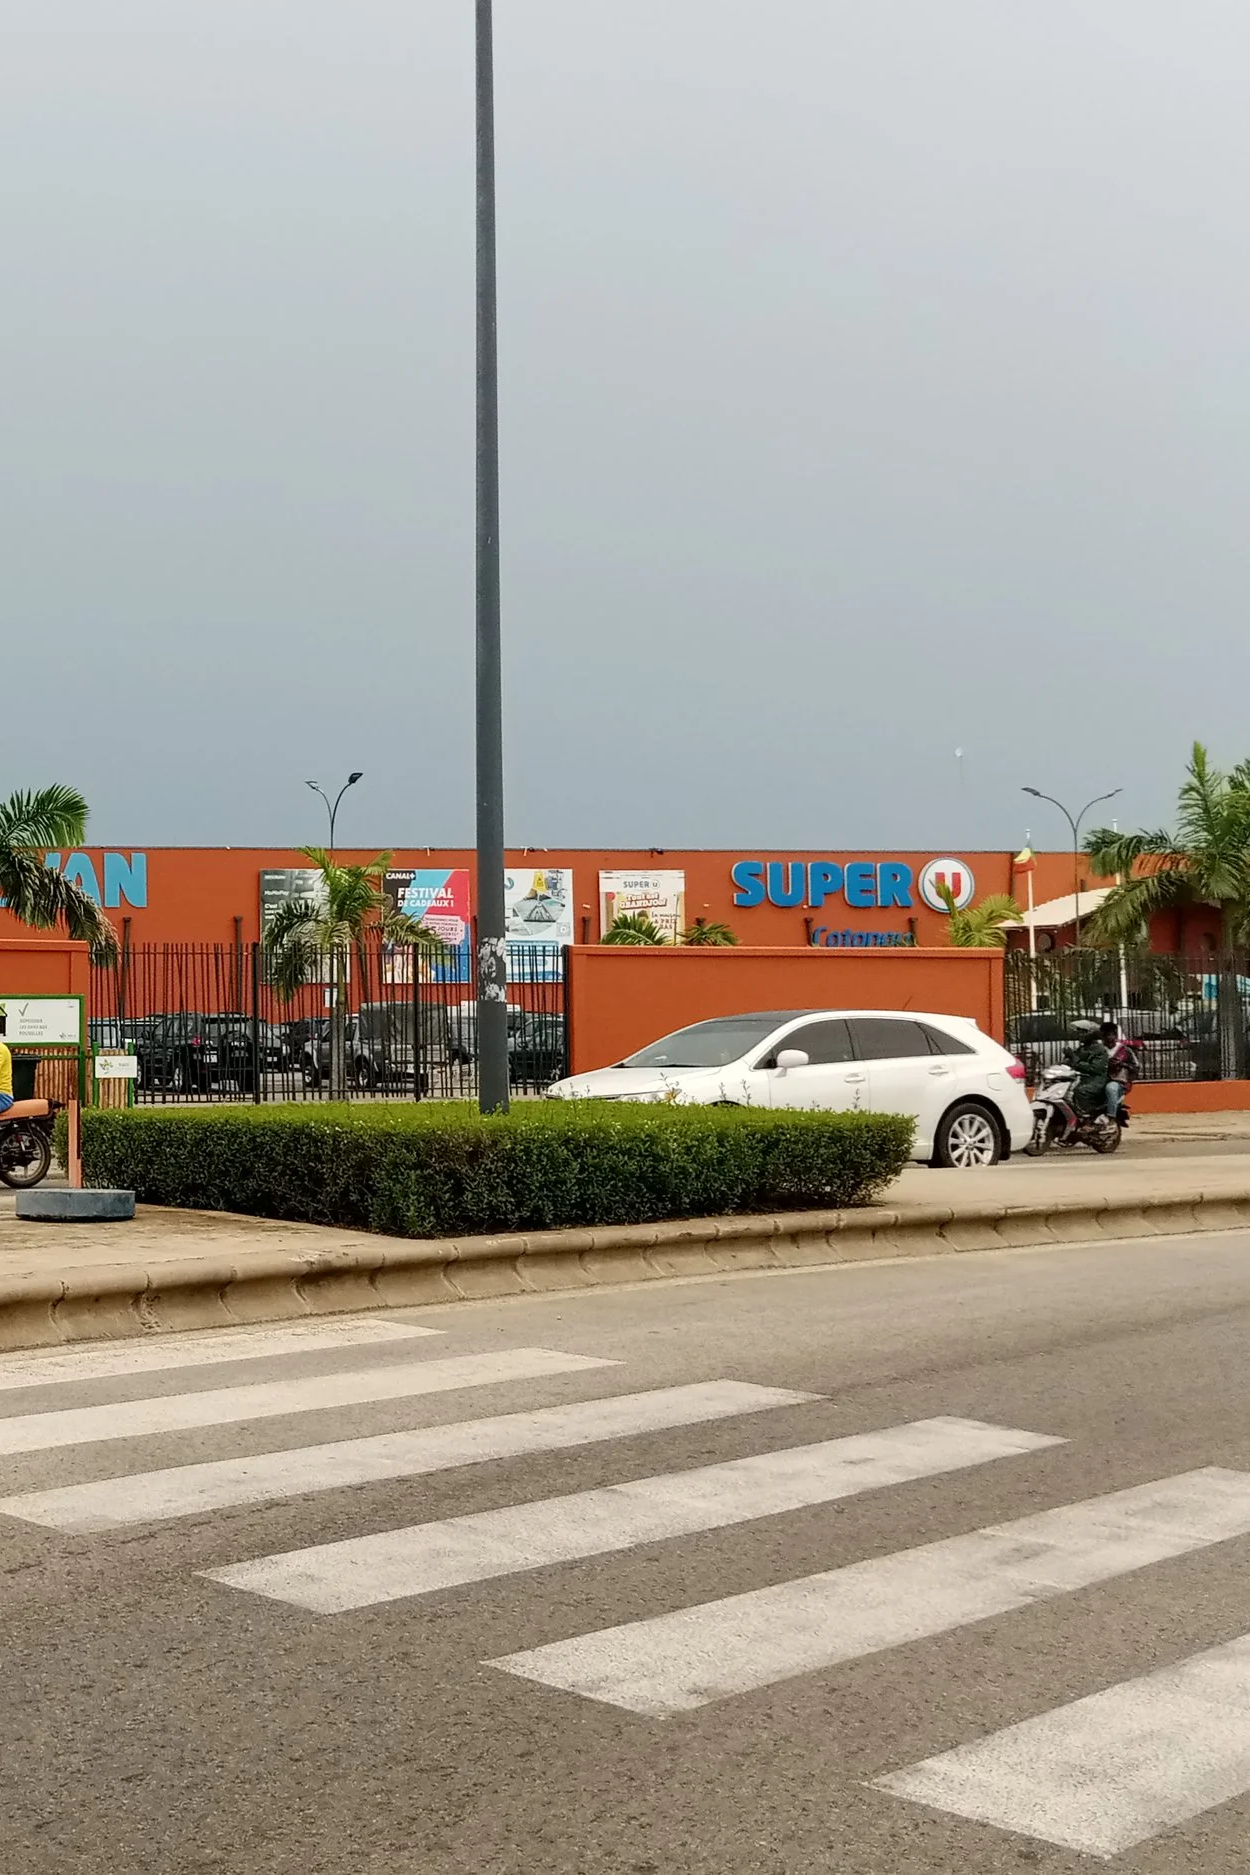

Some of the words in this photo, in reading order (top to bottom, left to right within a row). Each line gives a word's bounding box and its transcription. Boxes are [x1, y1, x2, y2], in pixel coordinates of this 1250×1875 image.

[385, 872, 416, 880] CANAL+
[731, 860, 914, 908] SUPER
[397, 887, 454, 899] FESTIVAL
[397, 899, 408, 907] DE
[409, 899, 449, 907] CADEAUX
